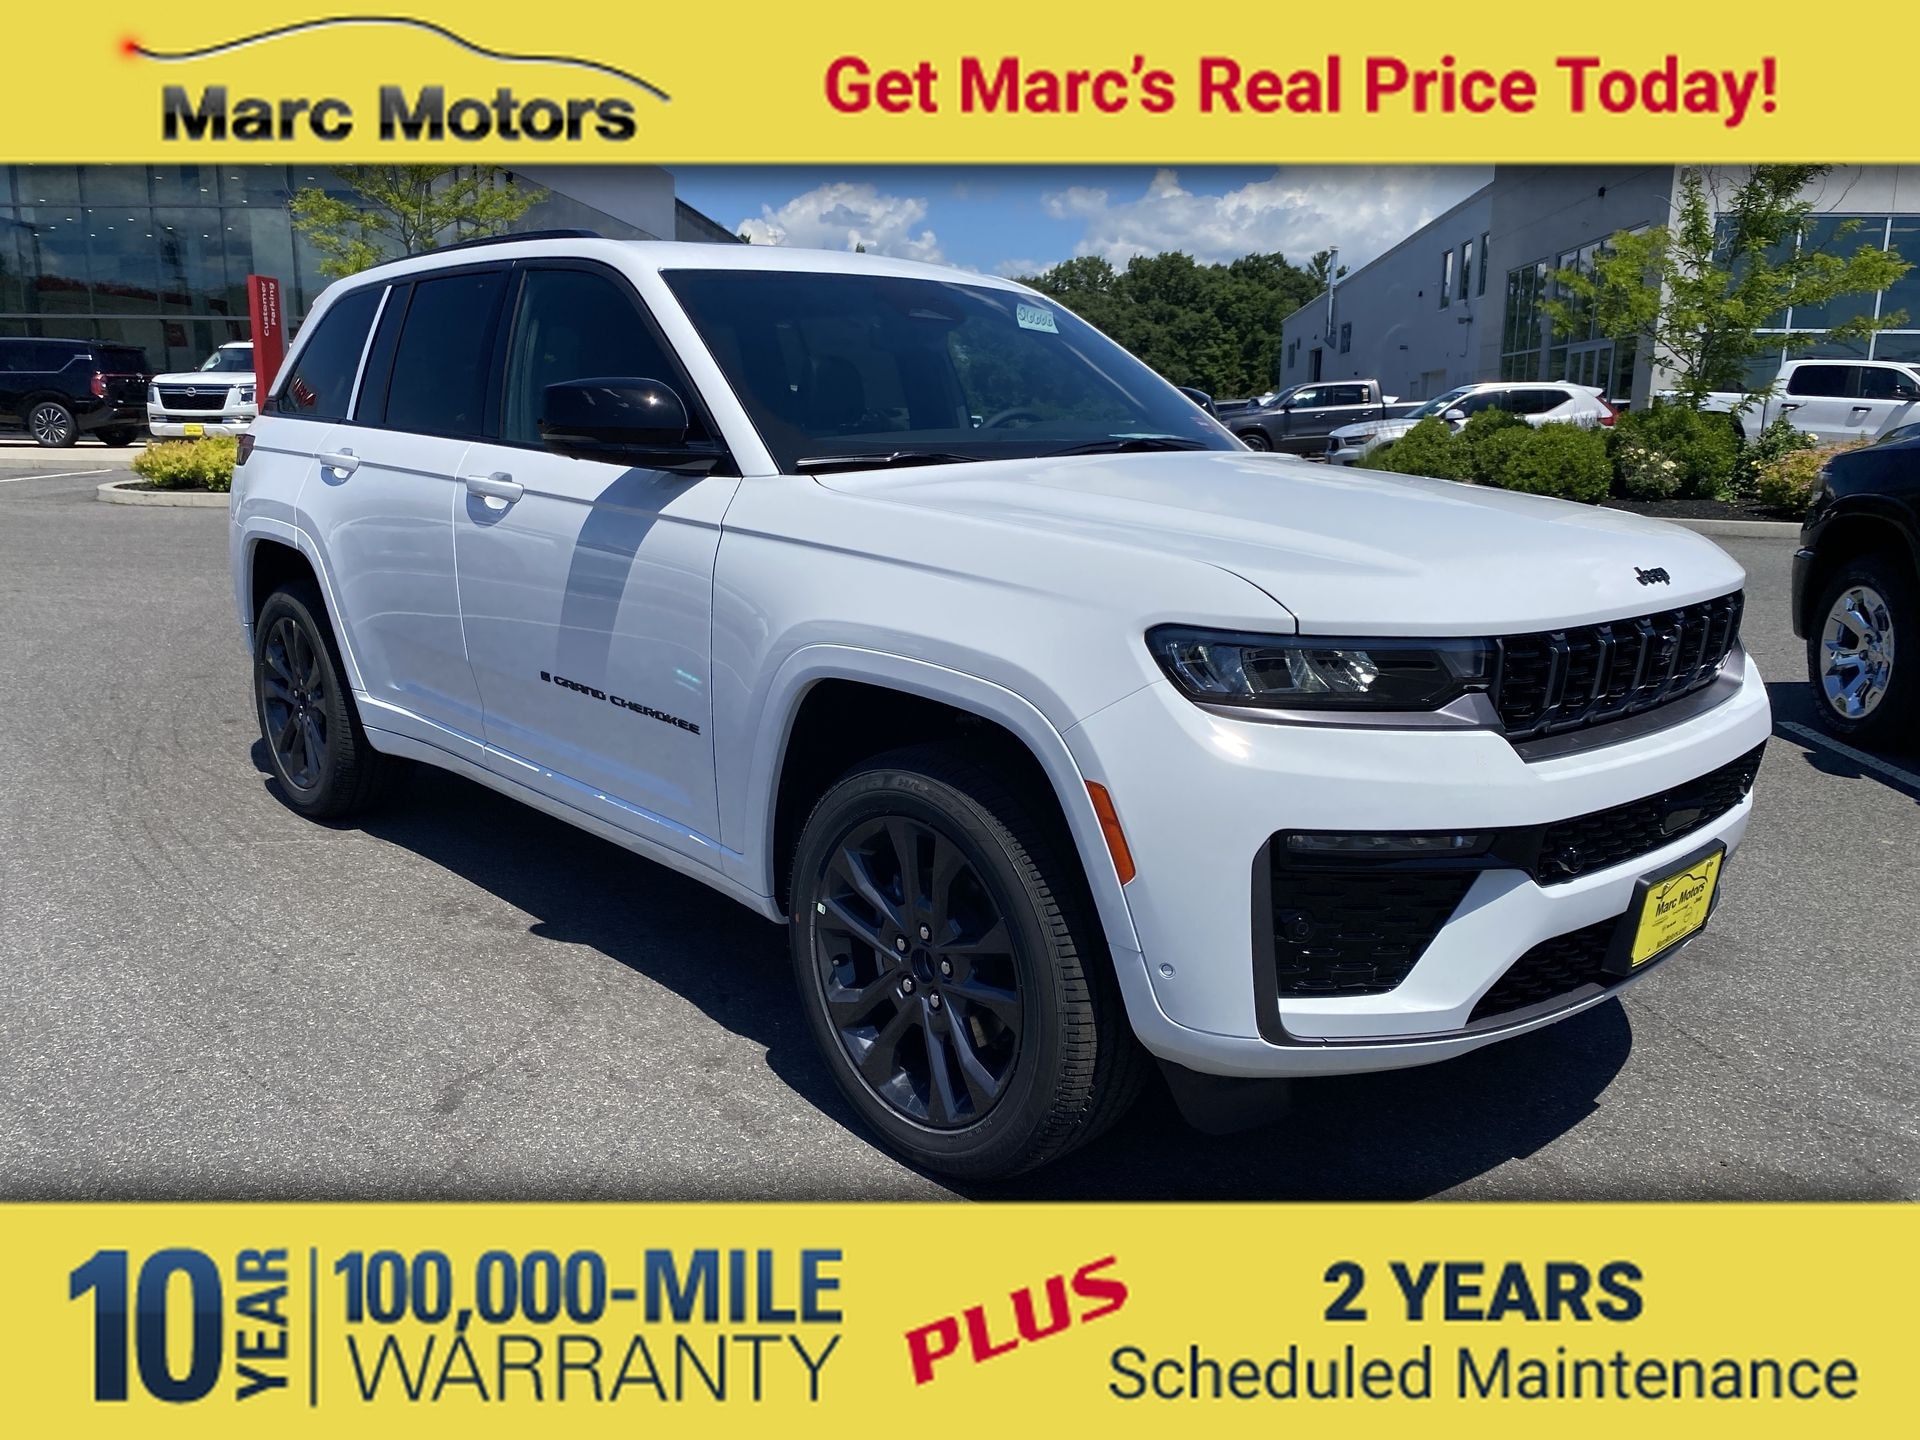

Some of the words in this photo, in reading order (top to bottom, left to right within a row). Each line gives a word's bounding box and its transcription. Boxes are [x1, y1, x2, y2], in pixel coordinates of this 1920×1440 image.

[261, 281, 269, 336] Customer
[1633, 566, 1671, 587] Jeep
[553, 675, 607, 701] GRAND
[610, 695, 701, 736] CHEROKEE
[1655, 898, 1678, 917] Marc
[1679, 882, 1705, 905] Motors
